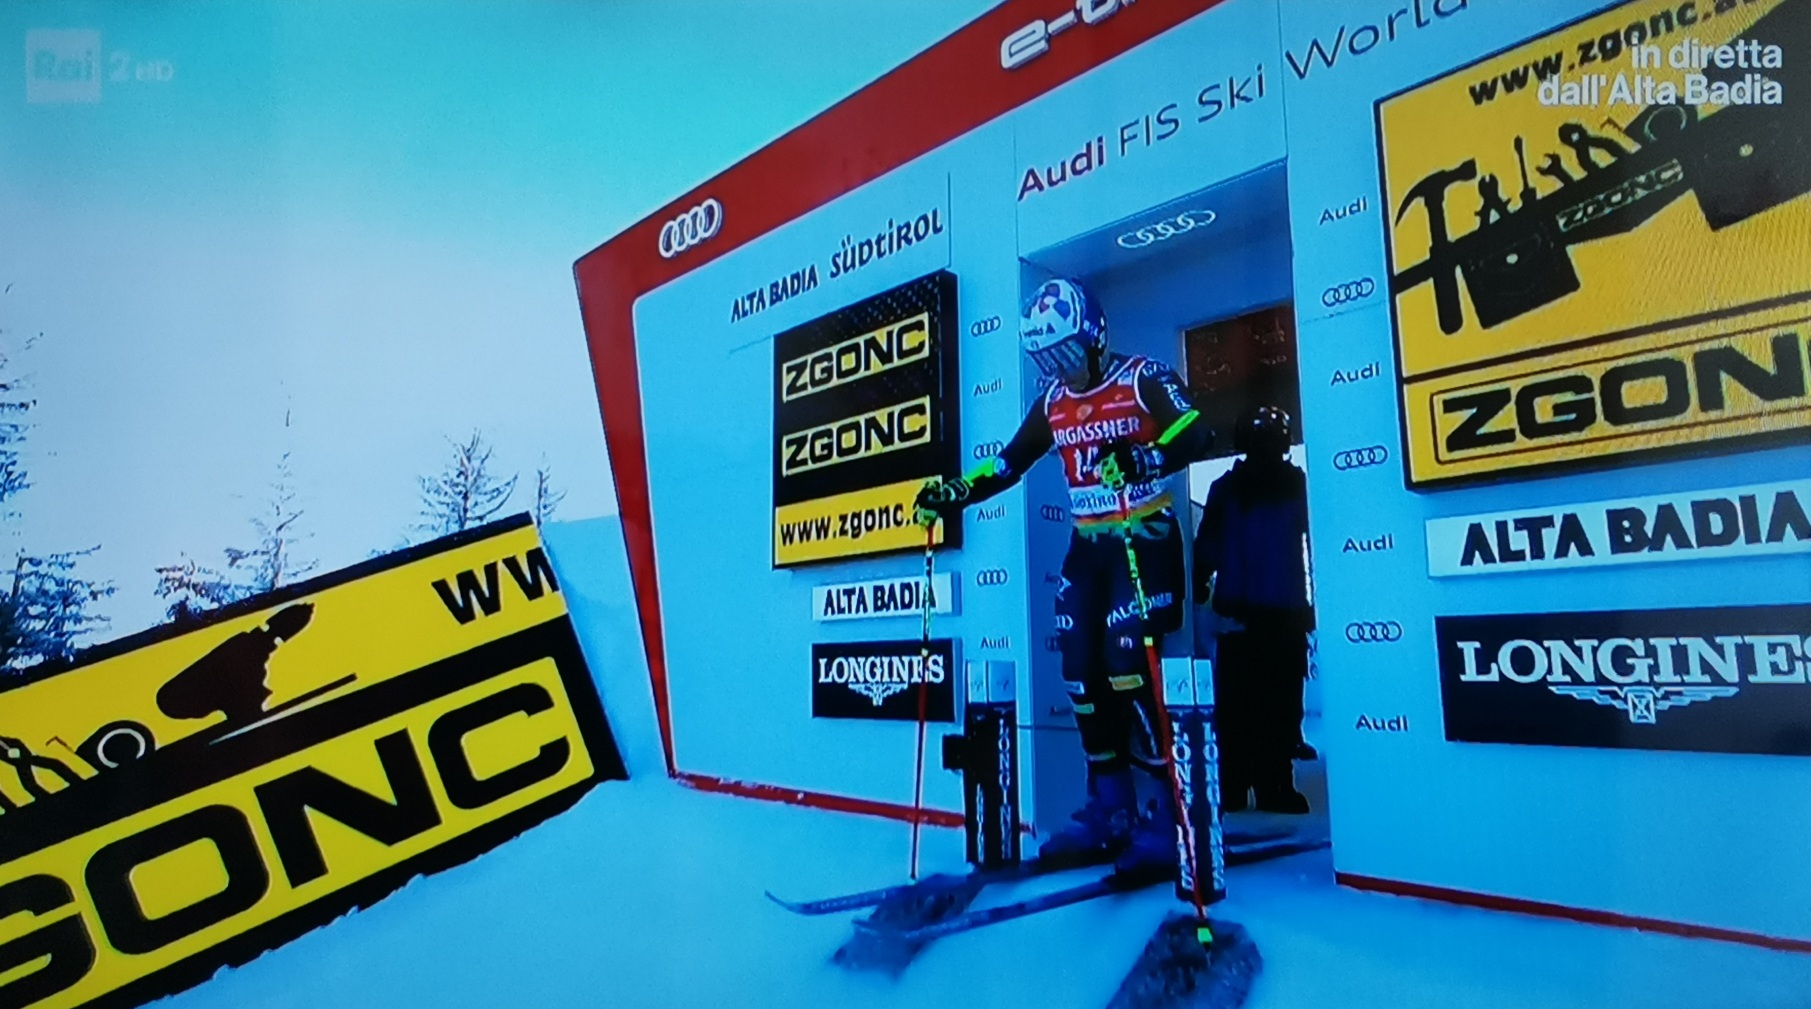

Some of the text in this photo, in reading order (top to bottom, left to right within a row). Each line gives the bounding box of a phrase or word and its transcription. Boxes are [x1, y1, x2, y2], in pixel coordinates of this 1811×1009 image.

[1017, 135, 1105, 201] Audi
[1119, 103, 1180, 157] FIS
[1197, 63, 1264, 123] Ski
[1557, 160, 1683, 231] ZGONC
[1319, 196, 1368, 226] Audi
[731, 263, 819, 324] ALTA BADIA
[784, 318, 927, 393] ZGONC
[973, 378, 1002, 397] Audi
[1330, 361, 1381, 386] Audi
[784, 404, 928, 470] ZGONC
[976, 504, 1006, 522] Audi
[1342, 533, 1394, 554] Audi
[1460, 490, 1811, 567] ALTA BADIA
[823, 586, 868, 617] ALTA
[980, 636, 1010, 650] Audi
[818, 654, 945, 684] LONGINES
[1355, 713, 1409, 733] Audi
